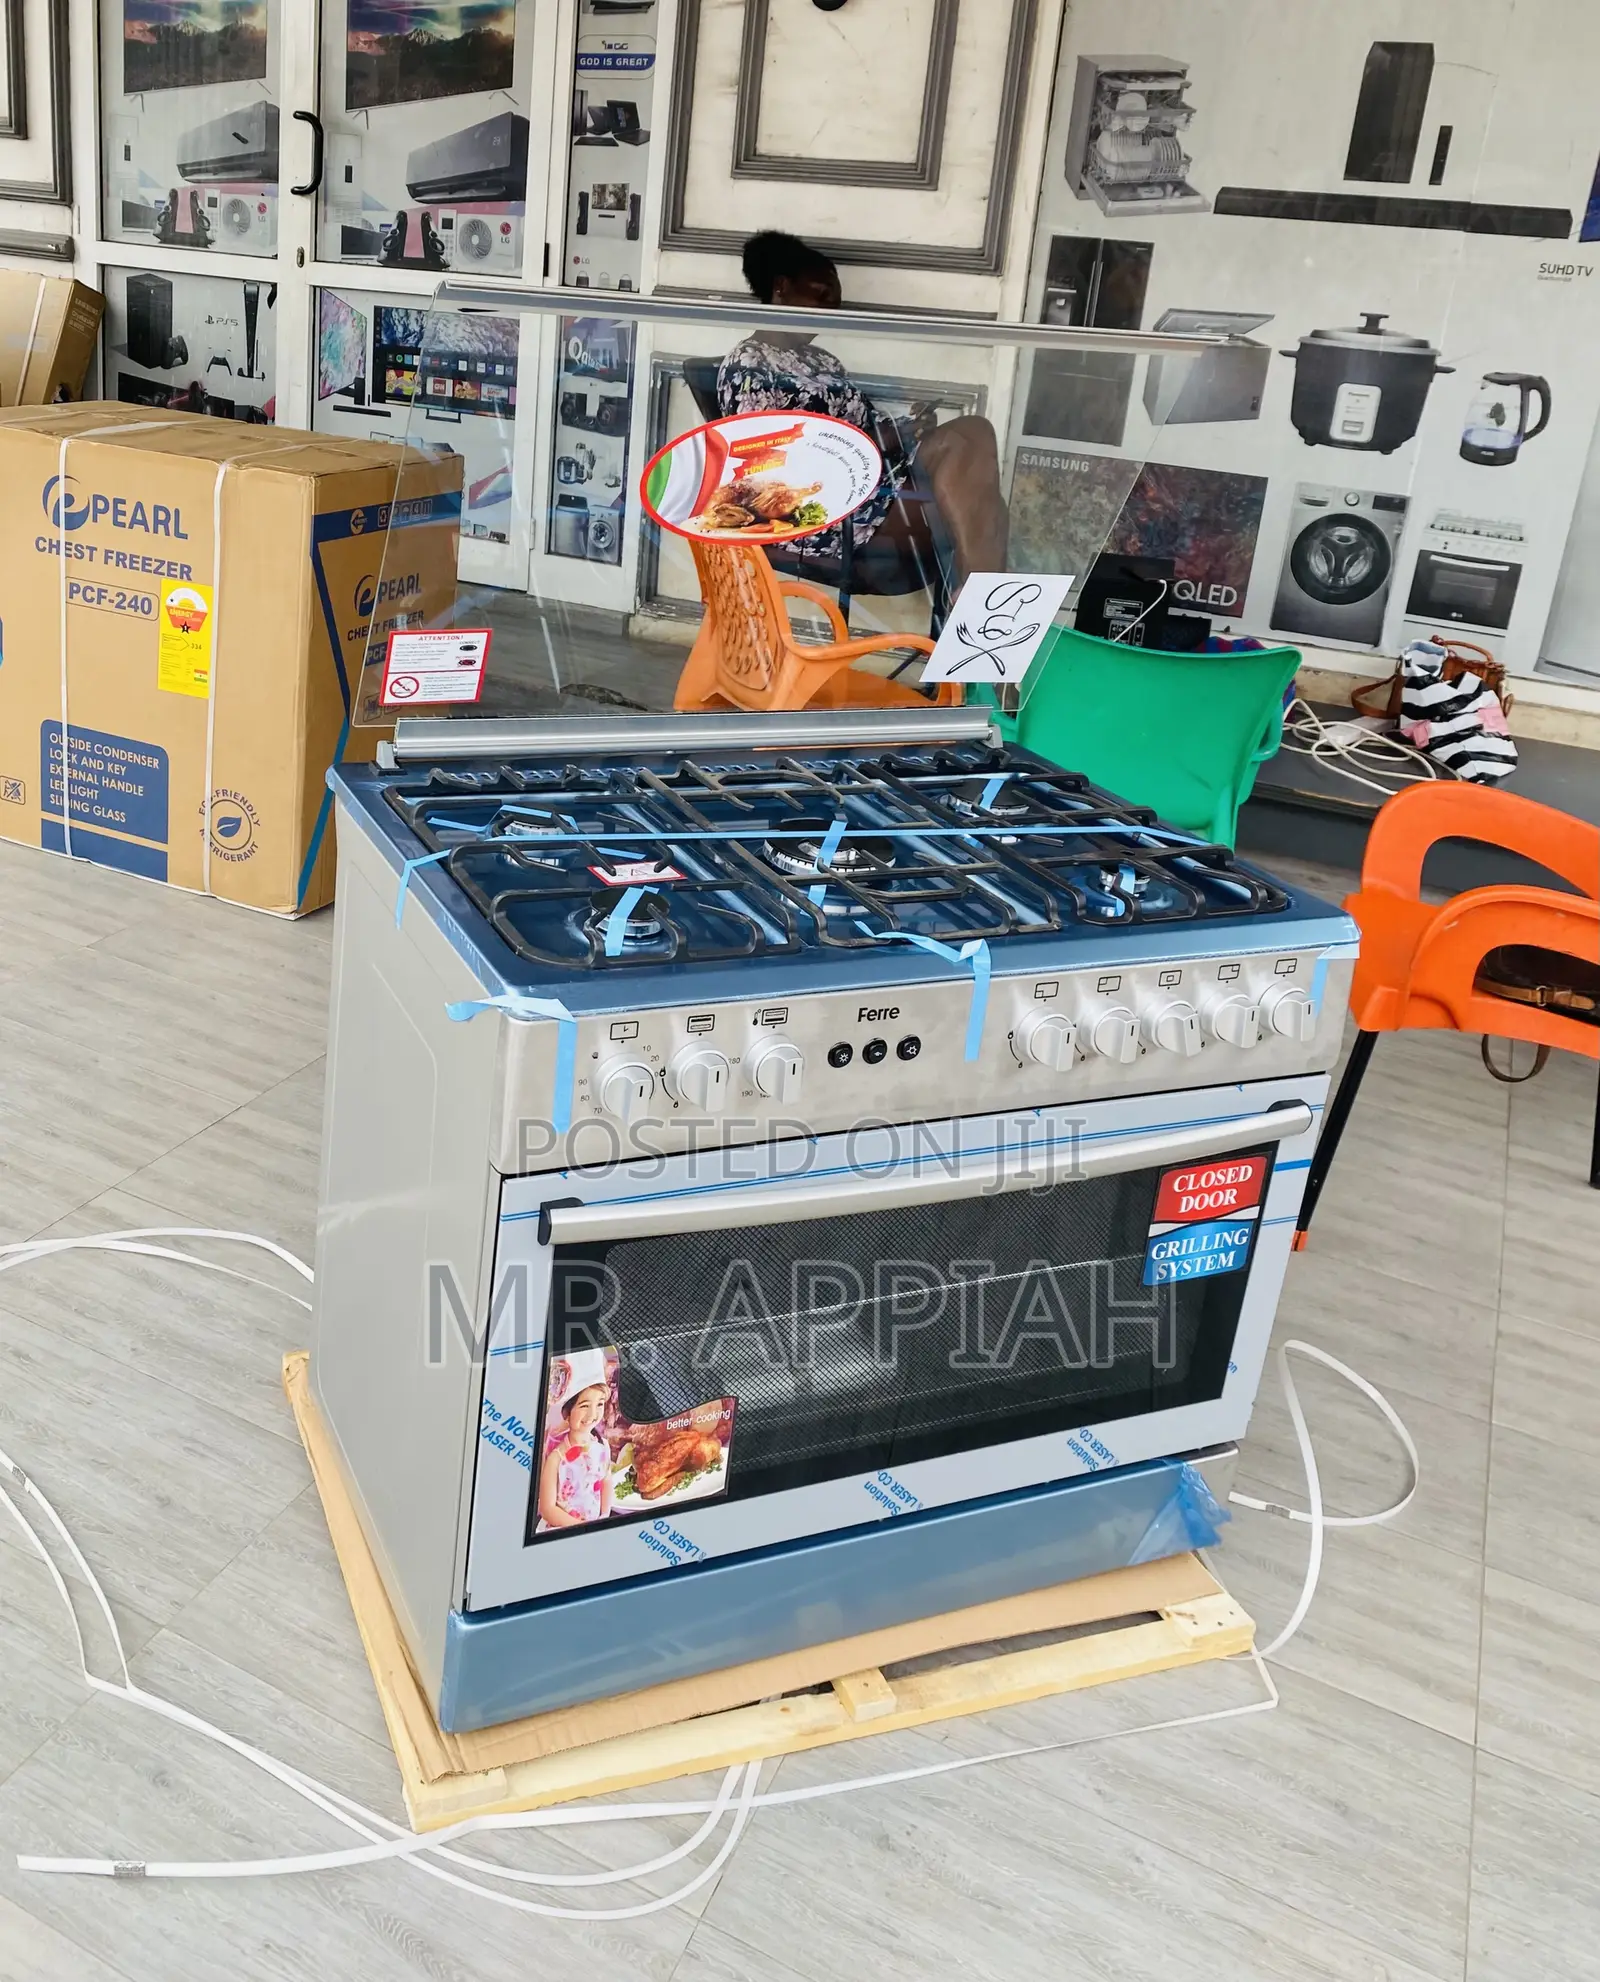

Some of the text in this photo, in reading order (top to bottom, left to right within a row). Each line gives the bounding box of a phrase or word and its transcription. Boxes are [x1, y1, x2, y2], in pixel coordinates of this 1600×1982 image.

[580, 57, 649, 66] GOD IS GREAT
[258, 215, 266, 223] LG
[500, 236, 510, 244] LG
[1538, 262, 1594, 277] SUHD TV
[216, 317, 239, 327] PS5
[733, 441, 766, 453] DESIGNED
[774, 436, 793, 445] ITALY
[1021, 453, 1090, 473] SAMSUNG
[92, 493, 189, 540] PEARL
[35, 536, 193, 581] CHEST FREEZER
[69, 582, 153, 615] PCF-240
[378, 572, 422, 604] PEARL
[1173, 579, 1238, 607] QLED
[418, 634, 464, 642] ATTENTION!
[49, 732, 160, 769] OUSIDE CONDENSER
[81, 756, 105, 771] AND
[107, 762, 127, 776] KEY
[49, 763, 144, 797] EXERNAL HANDLE
[70, 783, 99, 800] LIGHT
[49, 793, 126, 823] SLIING GLASS
[198, 788, 261, 827] EC-FRIENDLY
[857, 1006, 900, 1022] Ferre
[642, 1044, 652, 1052] 10
[650, 1054, 660, 1063] 20
[578, 1078, 588, 1087] 90
[741, 1090, 753, 1098] 190
[592, 1107, 603, 1115] 70
[1173, 1164, 1254, 1193] CLOSED
[1178, 1188, 1239, 1214] DOOR
[1151, 1227, 1250, 1261] GRILLING
[1156, 1250, 1237, 1281] SYSTEM
[482, 1399, 503, 1422] The
[666, 1409, 731, 1430] better cooking
[481, 1425, 532, 1472] LASER Fib
[1067, 1437, 1099, 1472] Solution
[1080, 1428, 1115, 1465] LASER CO
[864, 1480, 901, 1516] Solution
[890, 1481, 918, 1508] LASER
[653, 1519, 671, 1535] CO
[638, 1530, 682, 1567] Solution
[668, 1530, 700, 1558] LASER
